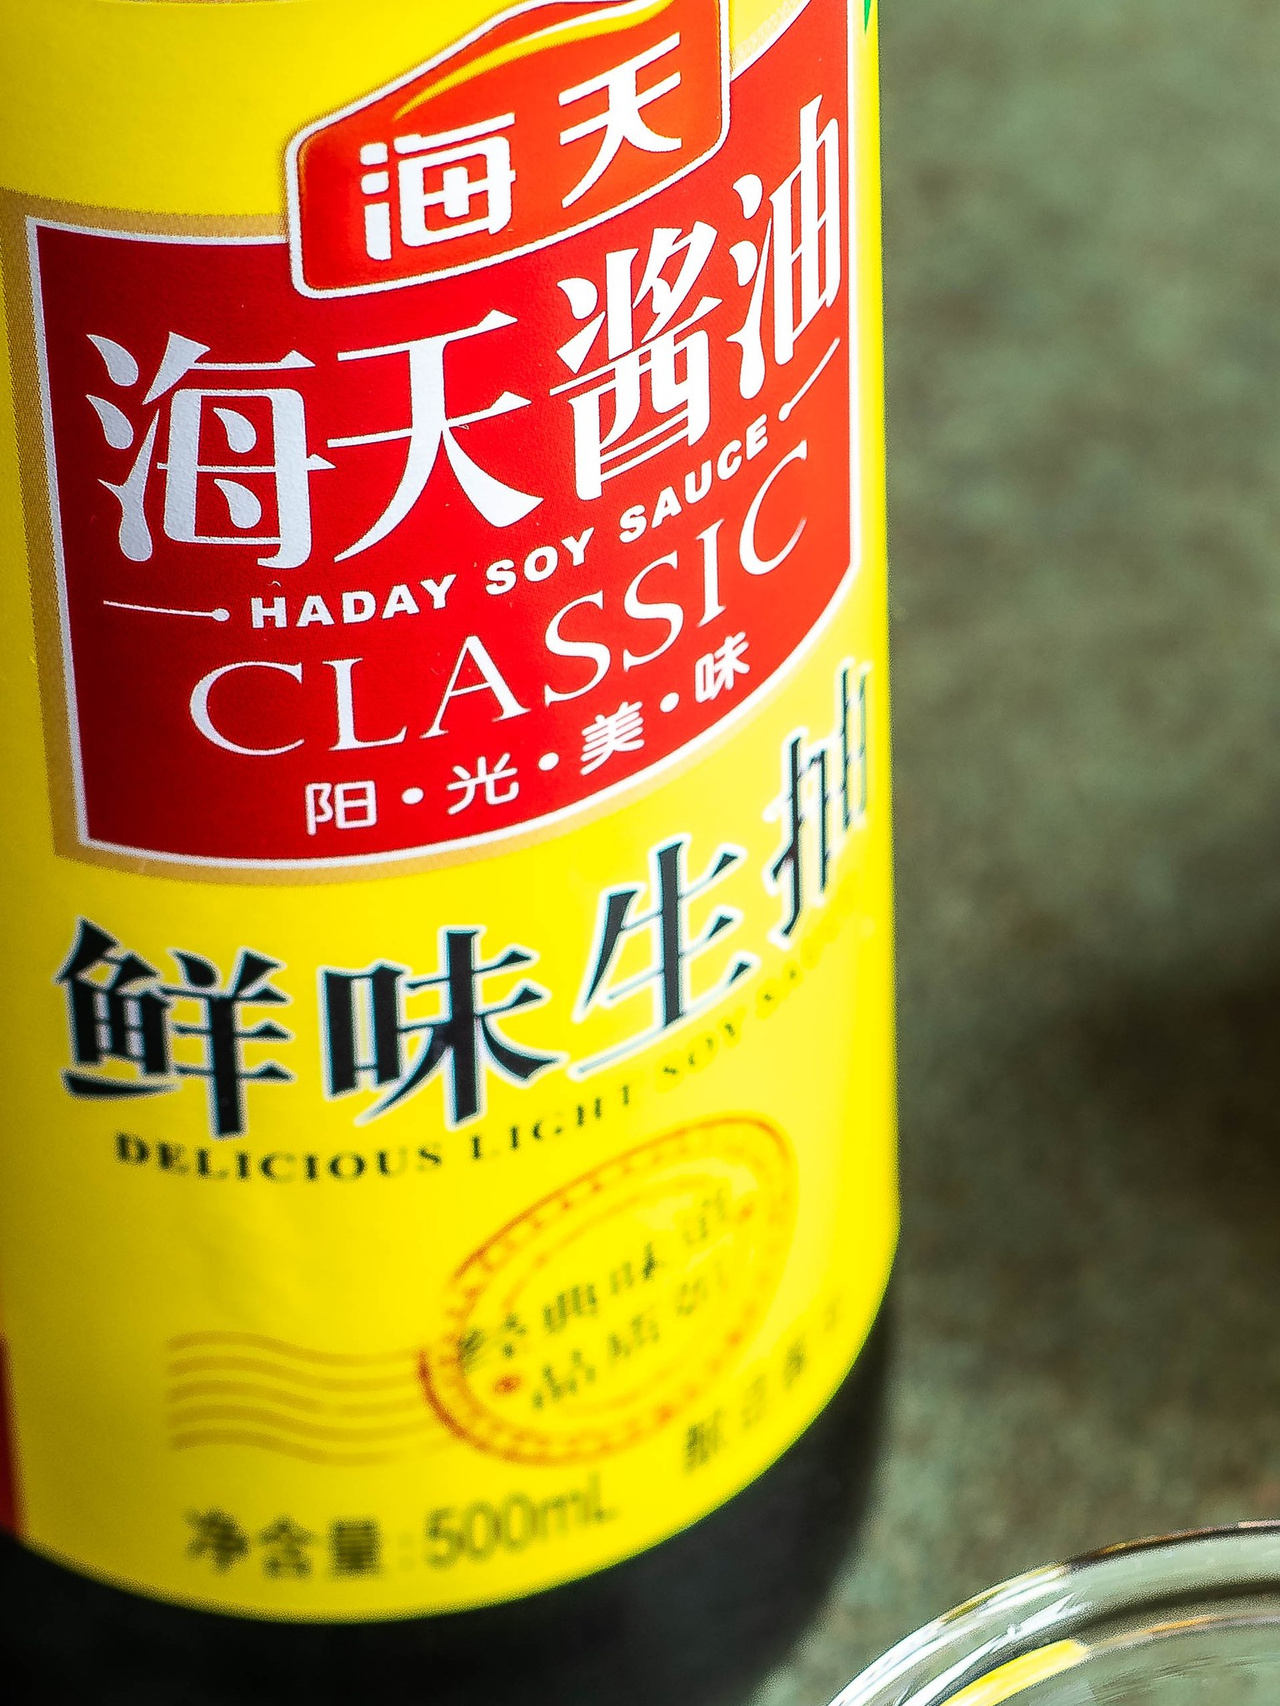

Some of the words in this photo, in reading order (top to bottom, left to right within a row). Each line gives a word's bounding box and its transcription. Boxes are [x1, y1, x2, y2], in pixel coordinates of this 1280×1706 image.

[359, 32, 682, 261] 海天
[85, 94, 844, 570] 海天酱油
[189, 439, 808, 757] CLASSIC
[251, 575, 457, 630] HADAY
[486, 527, 595, 596] SOY
[618, 413, 768, 544] SAUCE
[57, 665, 869, 1138] 鲜味生抽
[115, 1130, 445, 1184] DELICIOUS
[472, 1082, 642, 1162] LIGHT
